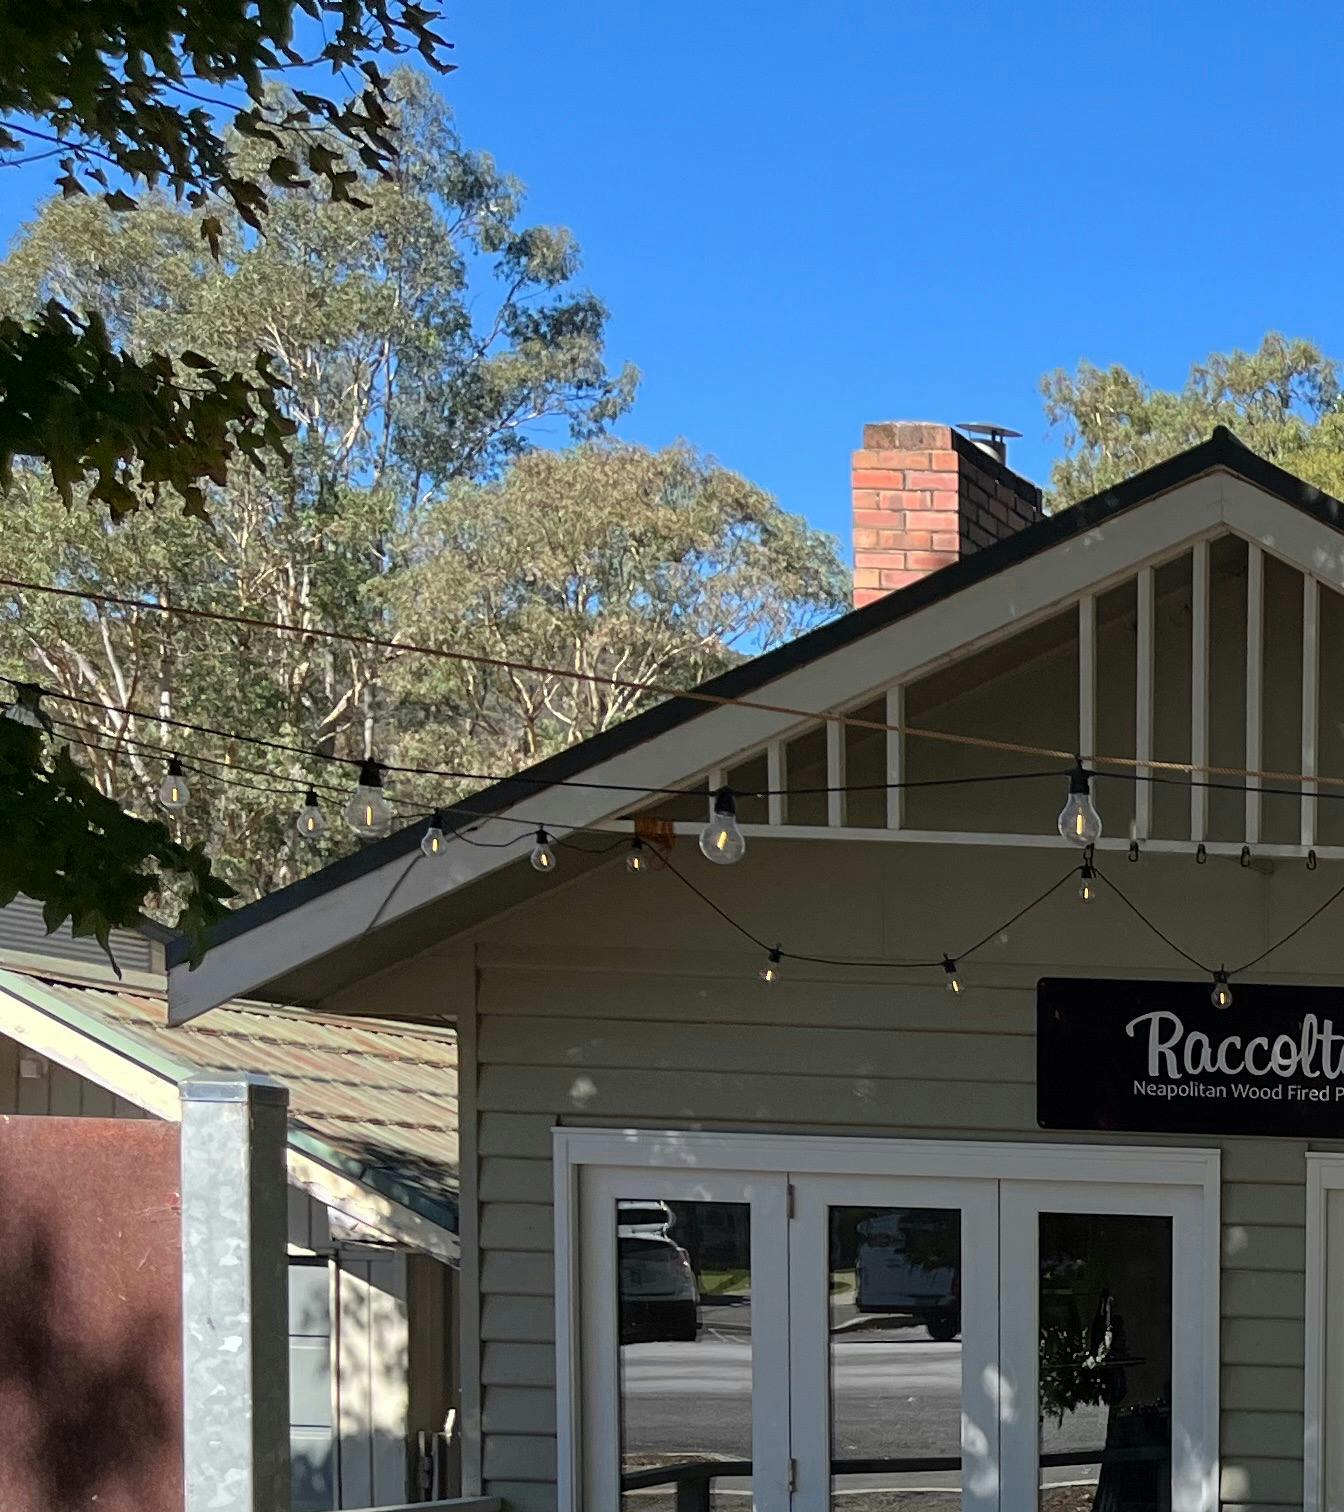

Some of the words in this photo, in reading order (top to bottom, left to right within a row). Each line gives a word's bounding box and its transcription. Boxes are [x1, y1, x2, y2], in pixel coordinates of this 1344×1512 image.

[1133, 1080, 1227, 1101] Neapolitan
[1231, 1083, 1283, 1100] Wood
[1287, 1084, 1330, 1102] Fired
